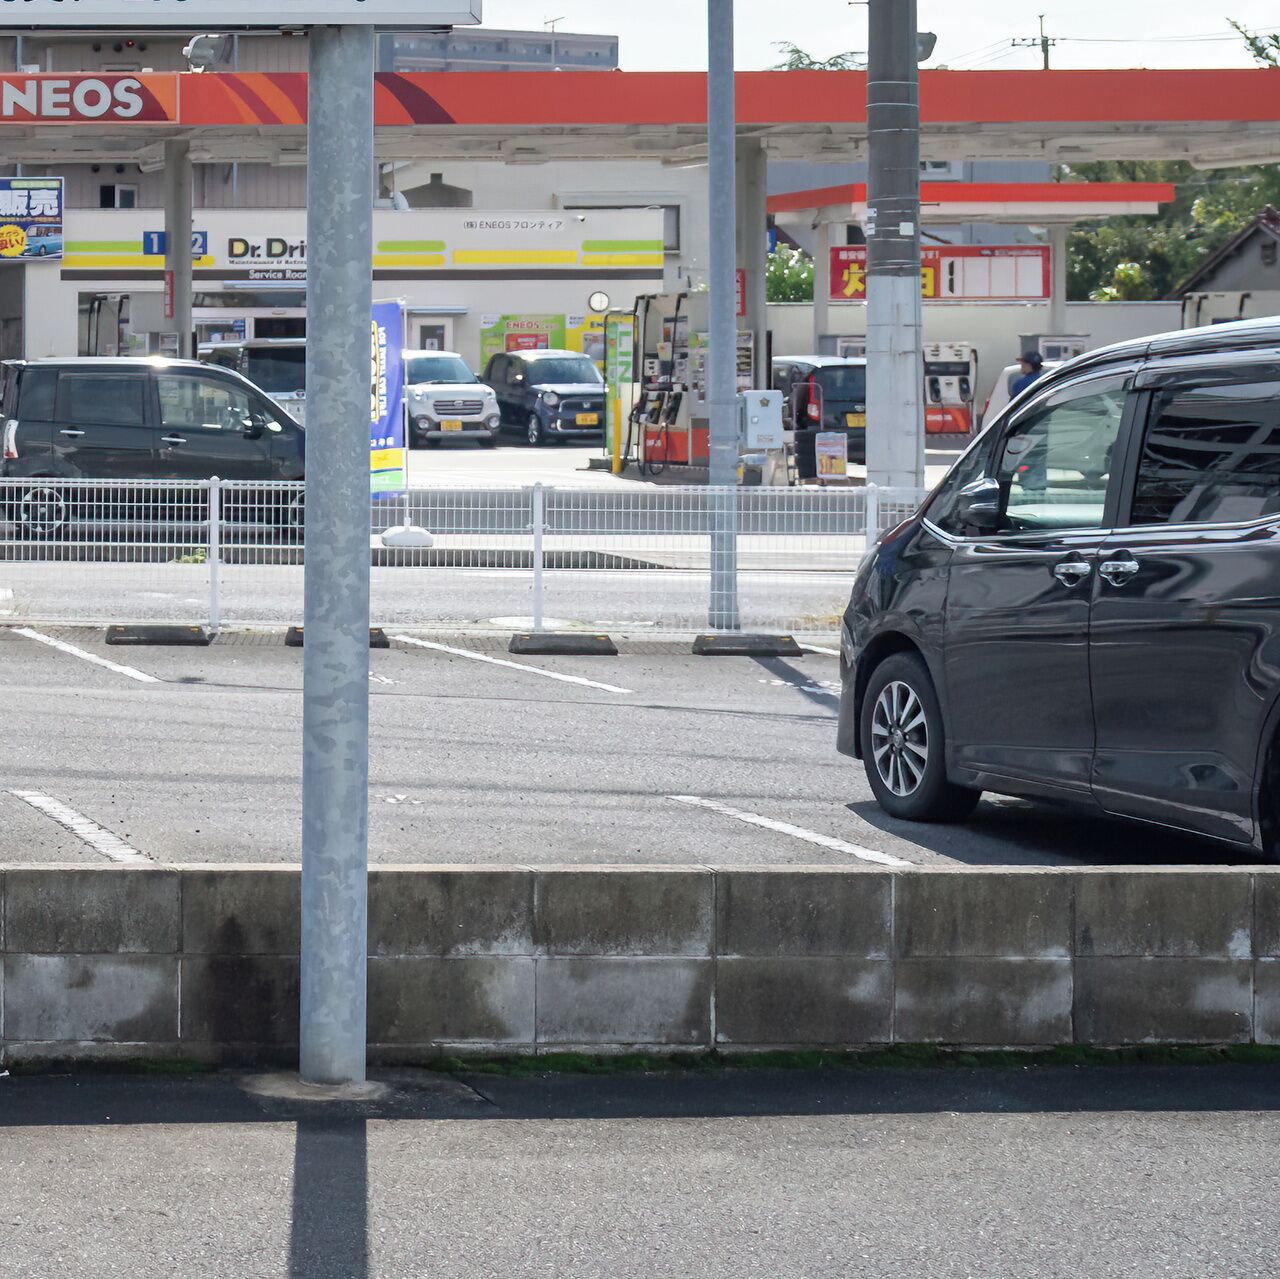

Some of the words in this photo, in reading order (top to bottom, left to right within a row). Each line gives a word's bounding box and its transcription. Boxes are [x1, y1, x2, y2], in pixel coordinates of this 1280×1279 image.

[150, 233, 159, 254] 1
[266, 237, 307, 259] Dri
[248, 269, 283, 280] Service
